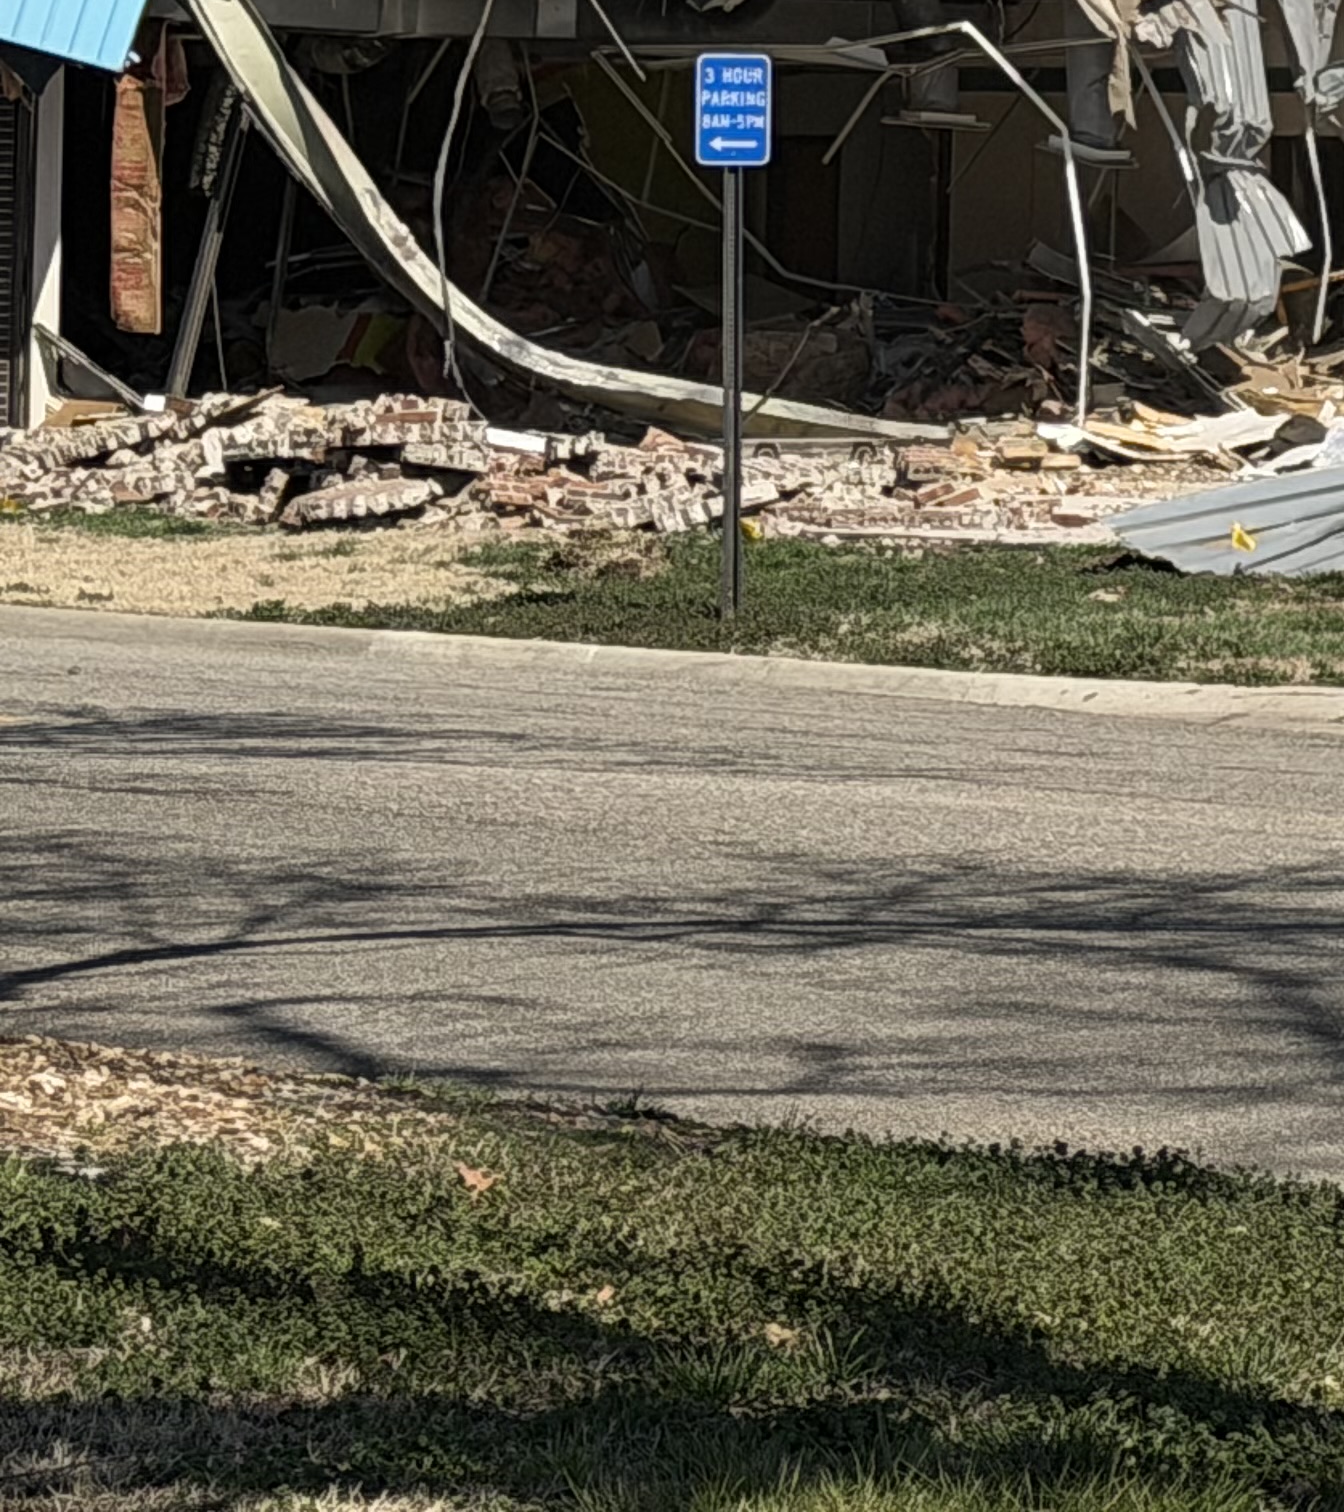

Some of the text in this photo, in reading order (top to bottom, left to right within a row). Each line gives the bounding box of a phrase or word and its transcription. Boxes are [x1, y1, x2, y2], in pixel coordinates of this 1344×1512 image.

[704, 67, 764, 84] 3 HOUR
[702, 90, 766, 107] PARKING
[702, 113, 765, 129] 8AM-5PM
